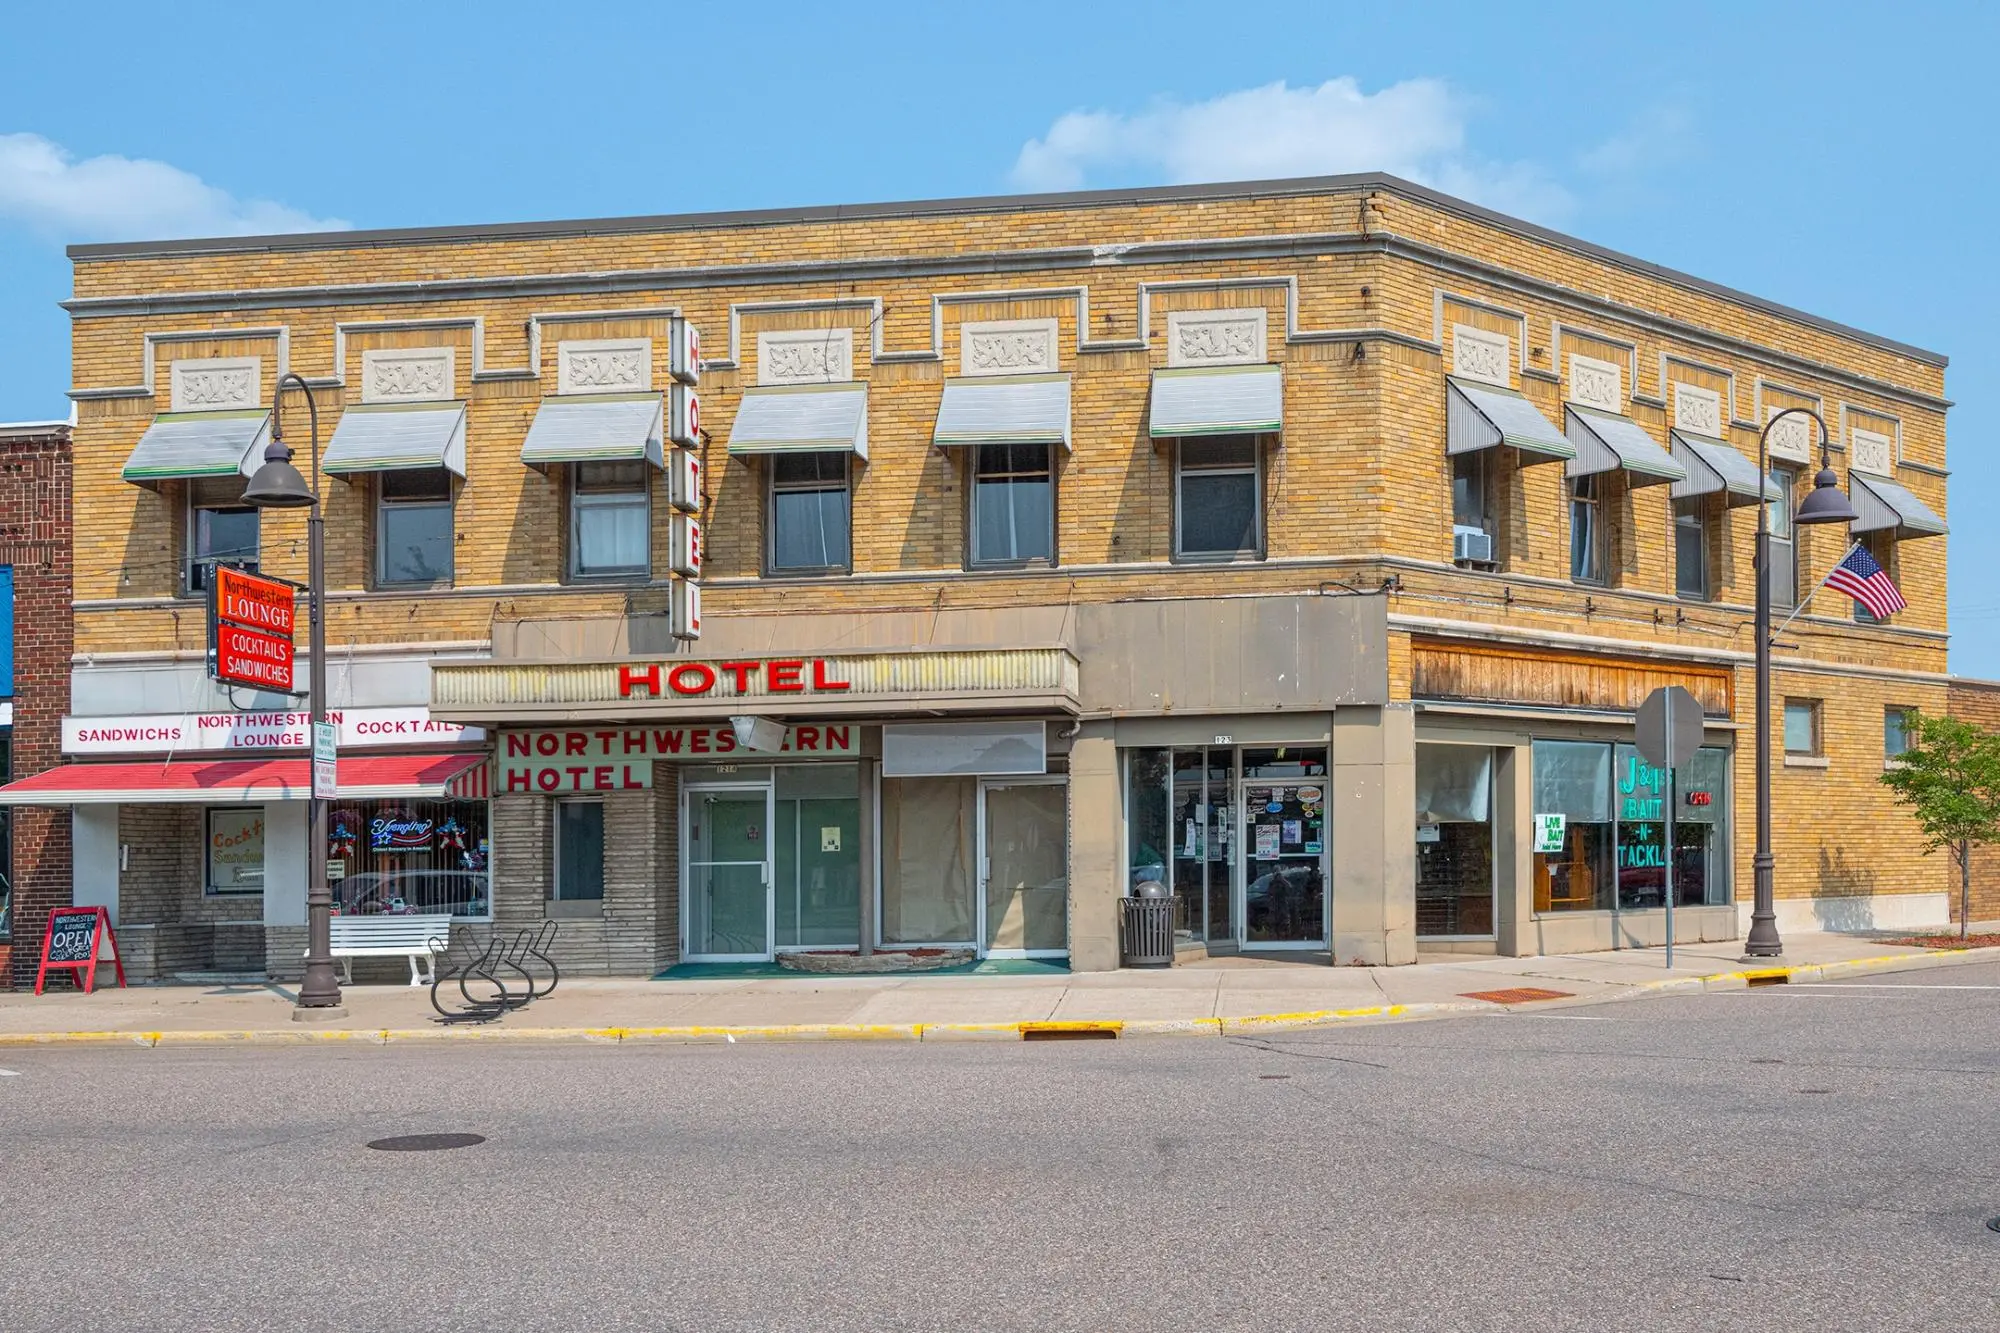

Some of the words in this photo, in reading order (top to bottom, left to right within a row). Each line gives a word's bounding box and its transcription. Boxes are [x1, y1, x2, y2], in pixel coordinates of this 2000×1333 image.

[689, 330, 699, 630] HOTEL
[225, 575, 292, 606] Northwestern
[227, 595, 290, 628] LOUNGE
[232, 634, 286, 661] COCKTAILS
[227, 656, 290, 684] SANDWICHES
[620, 659, 850, 697] HOTEL
[78, 728, 182, 742] SANDWICHS
[234, 733, 304, 747] LOUNGE
[508, 726, 849, 758] NORTHWESRN
[1216, 736, 1232, 744] 123
[508, 765, 643, 791] HOTEL
[1627, 798, 1662, 819] BAIT
[371, 819, 432, 834] Yuengling
[1545, 816, 1560, 828] LIVE
[1548, 829, 1563, 841] BAIT
[53, 930, 93, 947] OPEN
